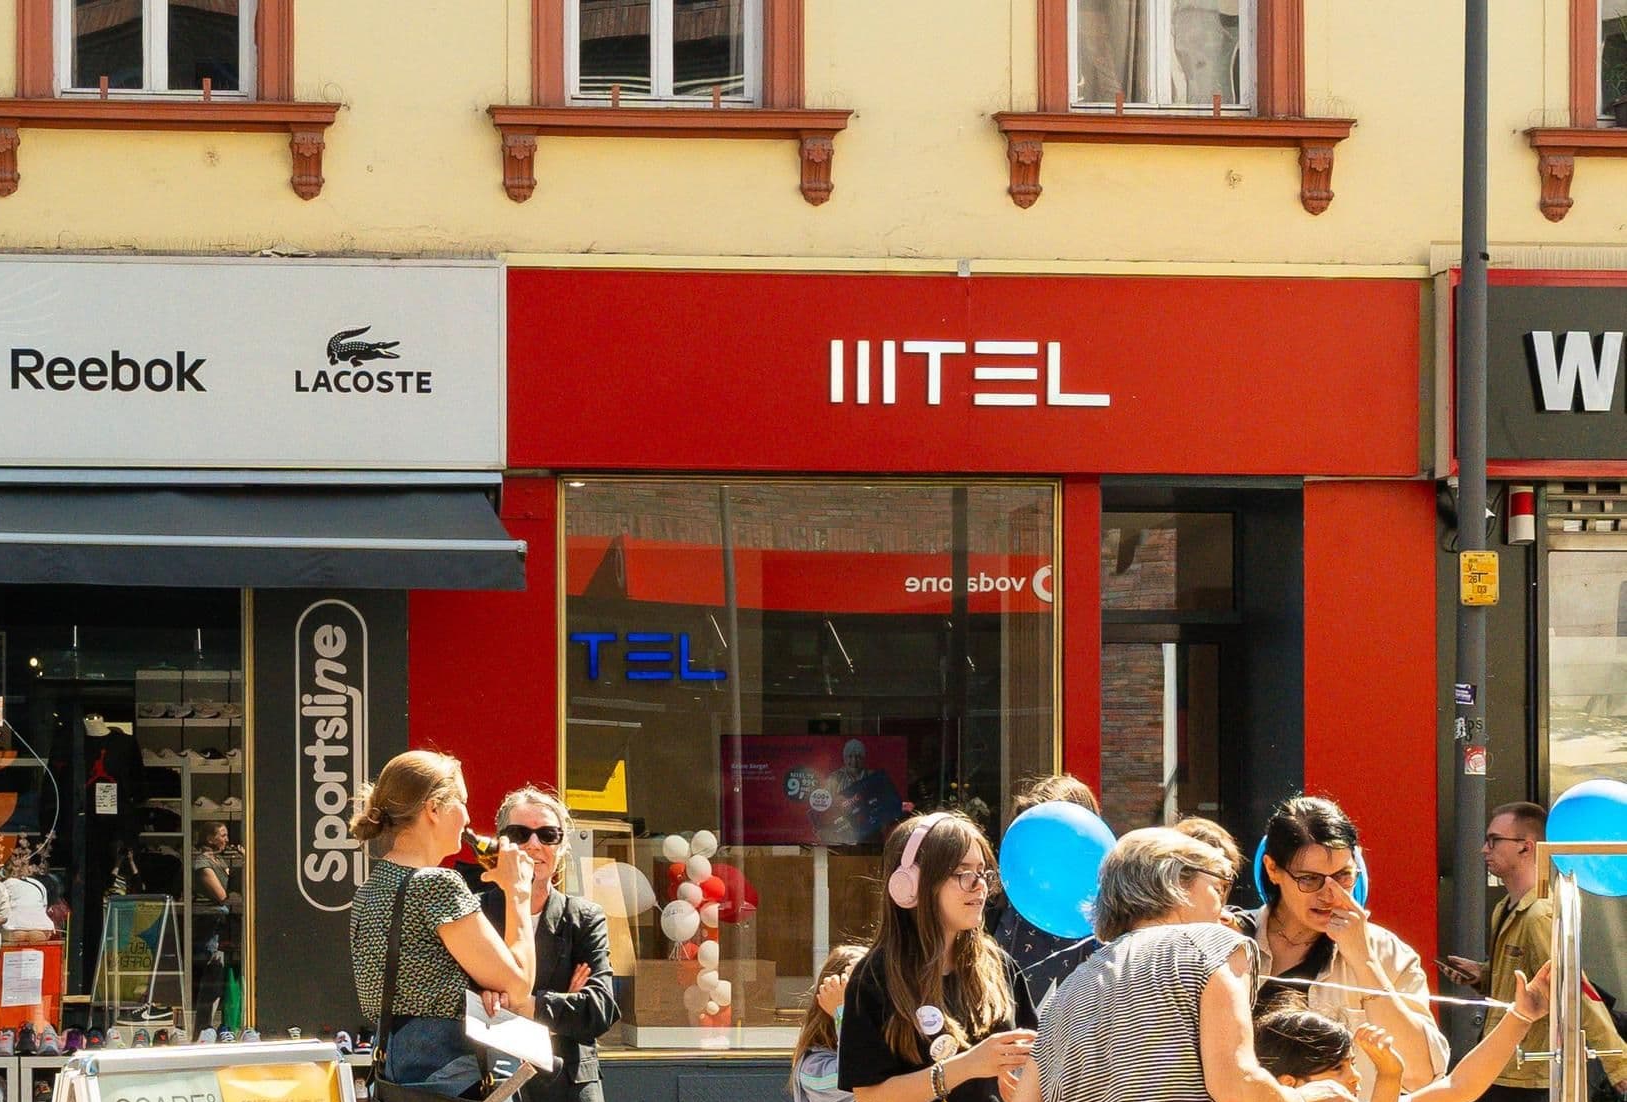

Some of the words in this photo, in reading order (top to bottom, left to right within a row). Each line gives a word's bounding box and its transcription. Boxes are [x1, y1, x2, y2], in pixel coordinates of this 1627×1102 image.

[11, 348, 207, 393] Reebok
[295, 369, 433, 394] LACOSTE
[1532, 331, 1624, 411] W
[301, 624, 360, 882] Sportsline
